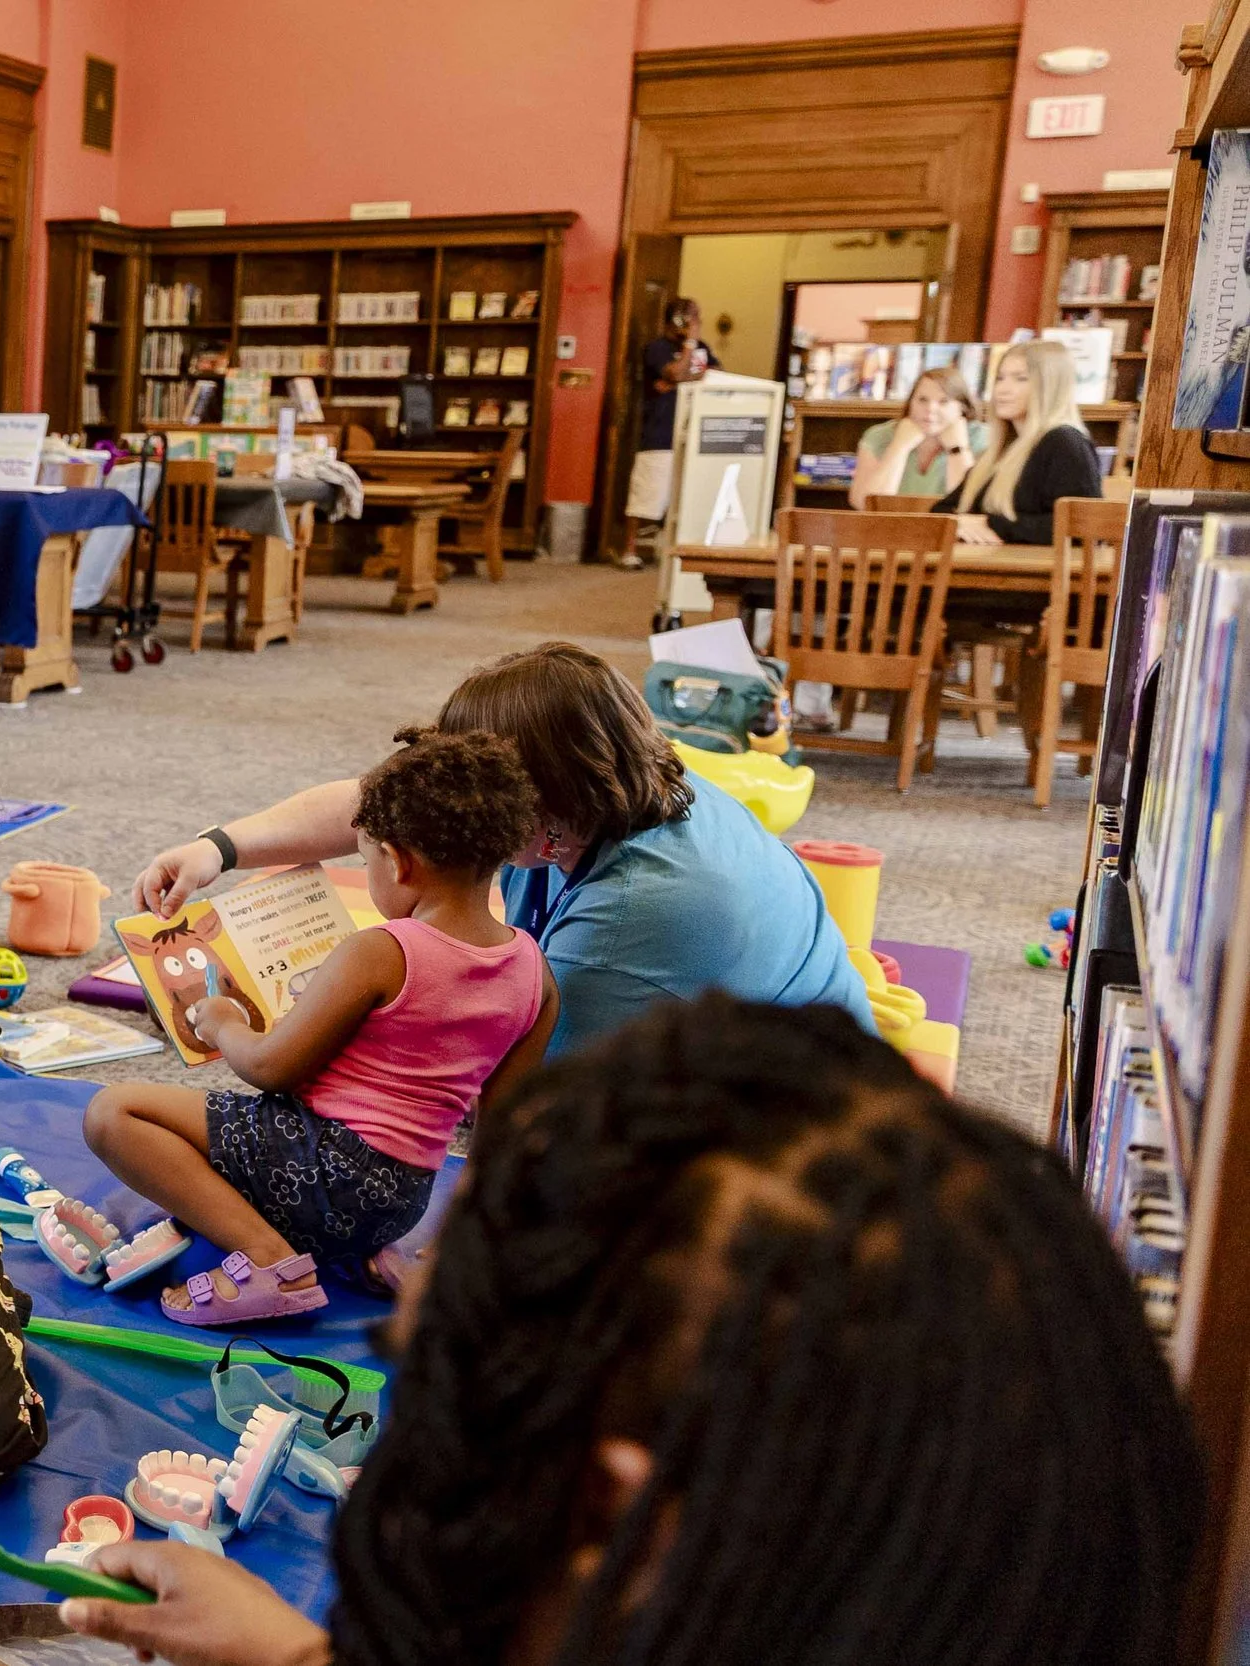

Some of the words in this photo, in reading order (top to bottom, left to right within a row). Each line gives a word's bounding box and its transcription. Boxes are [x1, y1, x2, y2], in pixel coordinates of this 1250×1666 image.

[1227, 185, 1250, 253] PHILIP
[1208, 270, 1219, 306] CHRIS
[1211, 263, 1240, 363] PULLMAN
[229, 905, 252, 918] Hungry
[252, 894, 277, 910] HORSE
